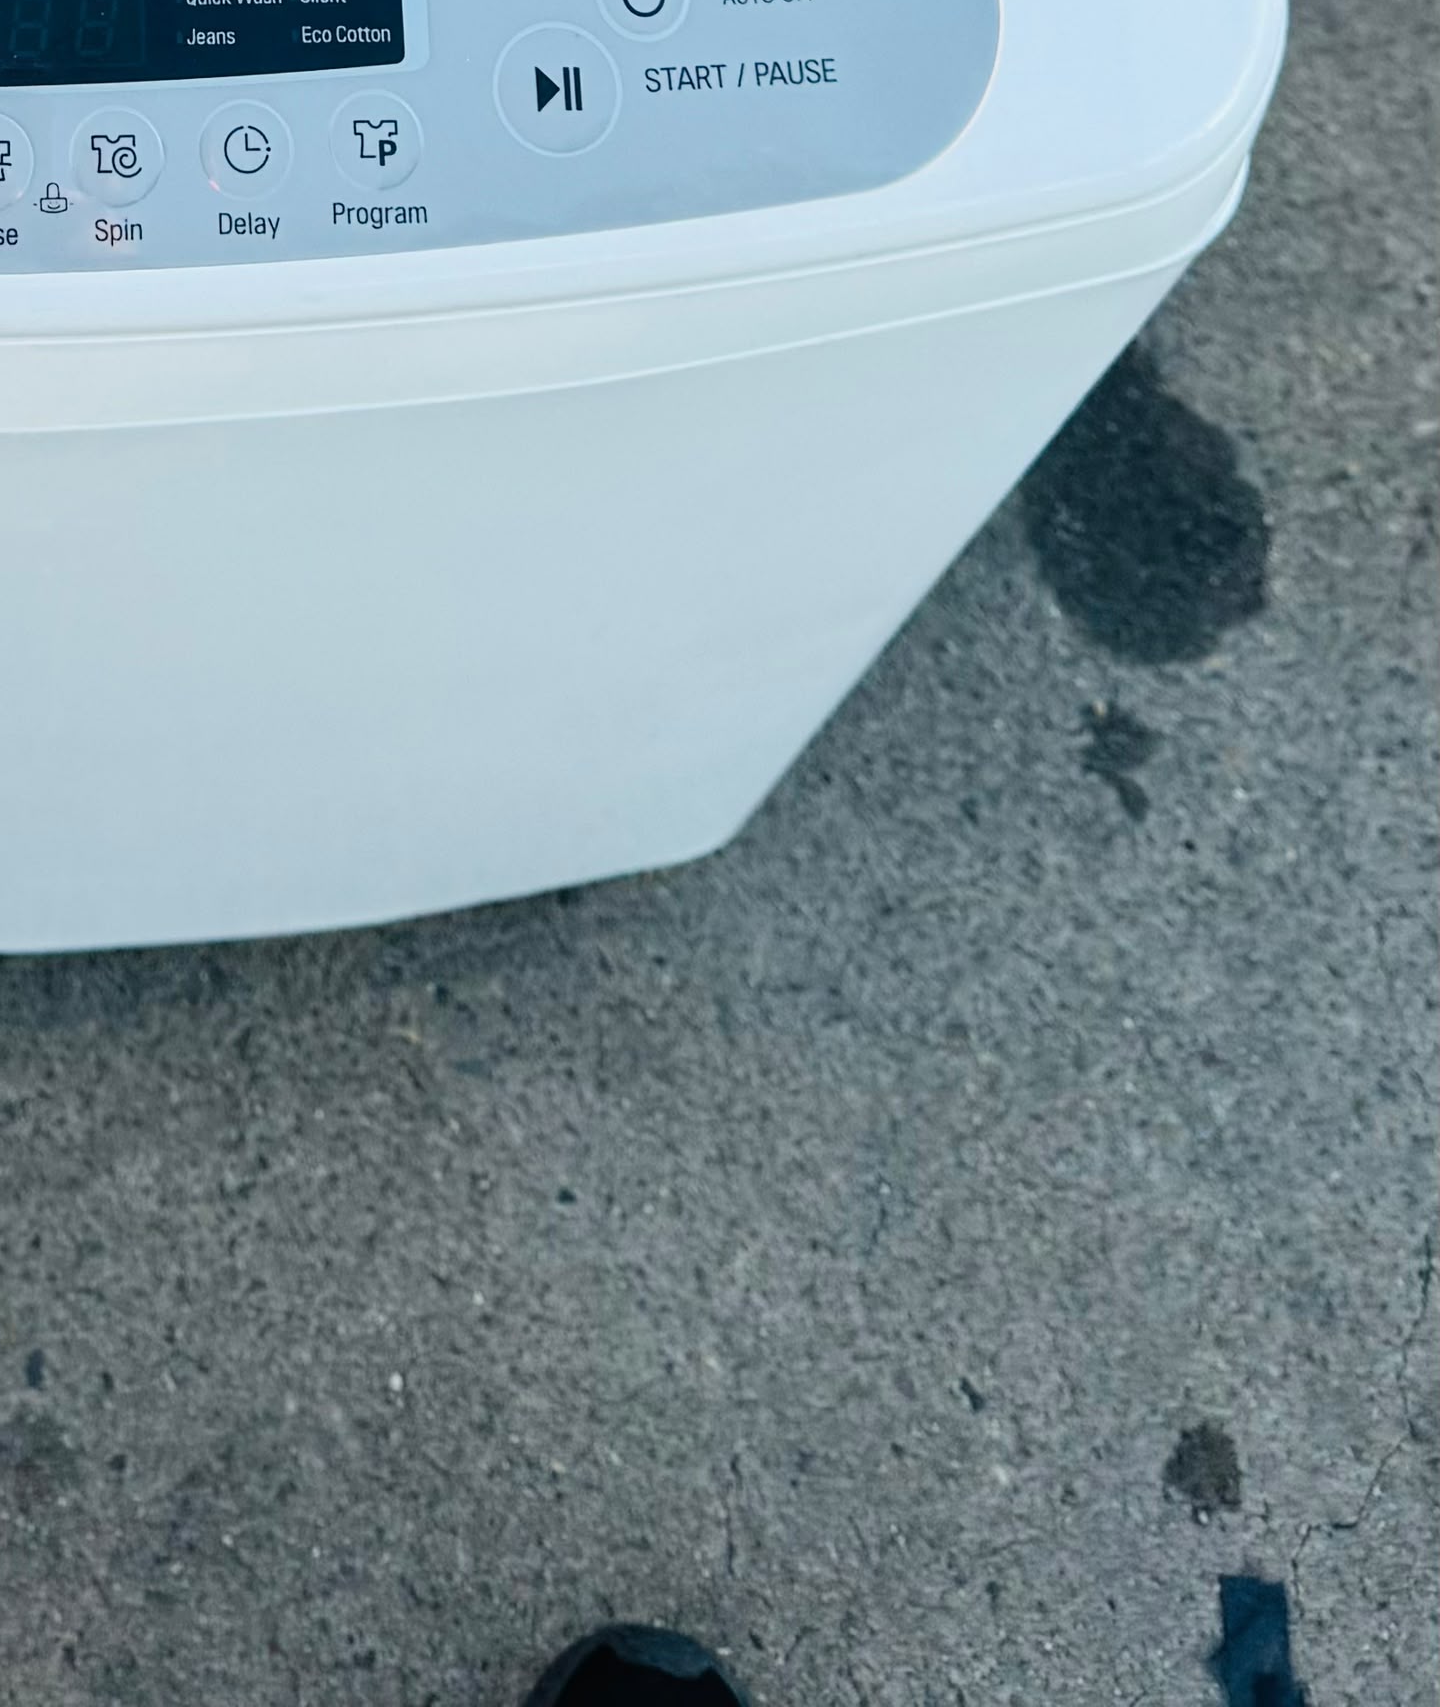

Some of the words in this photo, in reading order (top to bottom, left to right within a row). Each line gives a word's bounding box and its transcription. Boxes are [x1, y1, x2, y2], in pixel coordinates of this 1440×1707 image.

[186, 28, 236, 45] Jeans
[301, 25, 332, 44] Eco
[335, 25, 391, 43] Cotton
[644, 64, 727, 93] START
[754, 58, 838, 87] PAUSE
[218, 211, 281, 240] Delay
[332, 202, 428, 230] Program
[94, 218, 143, 247] Spin
